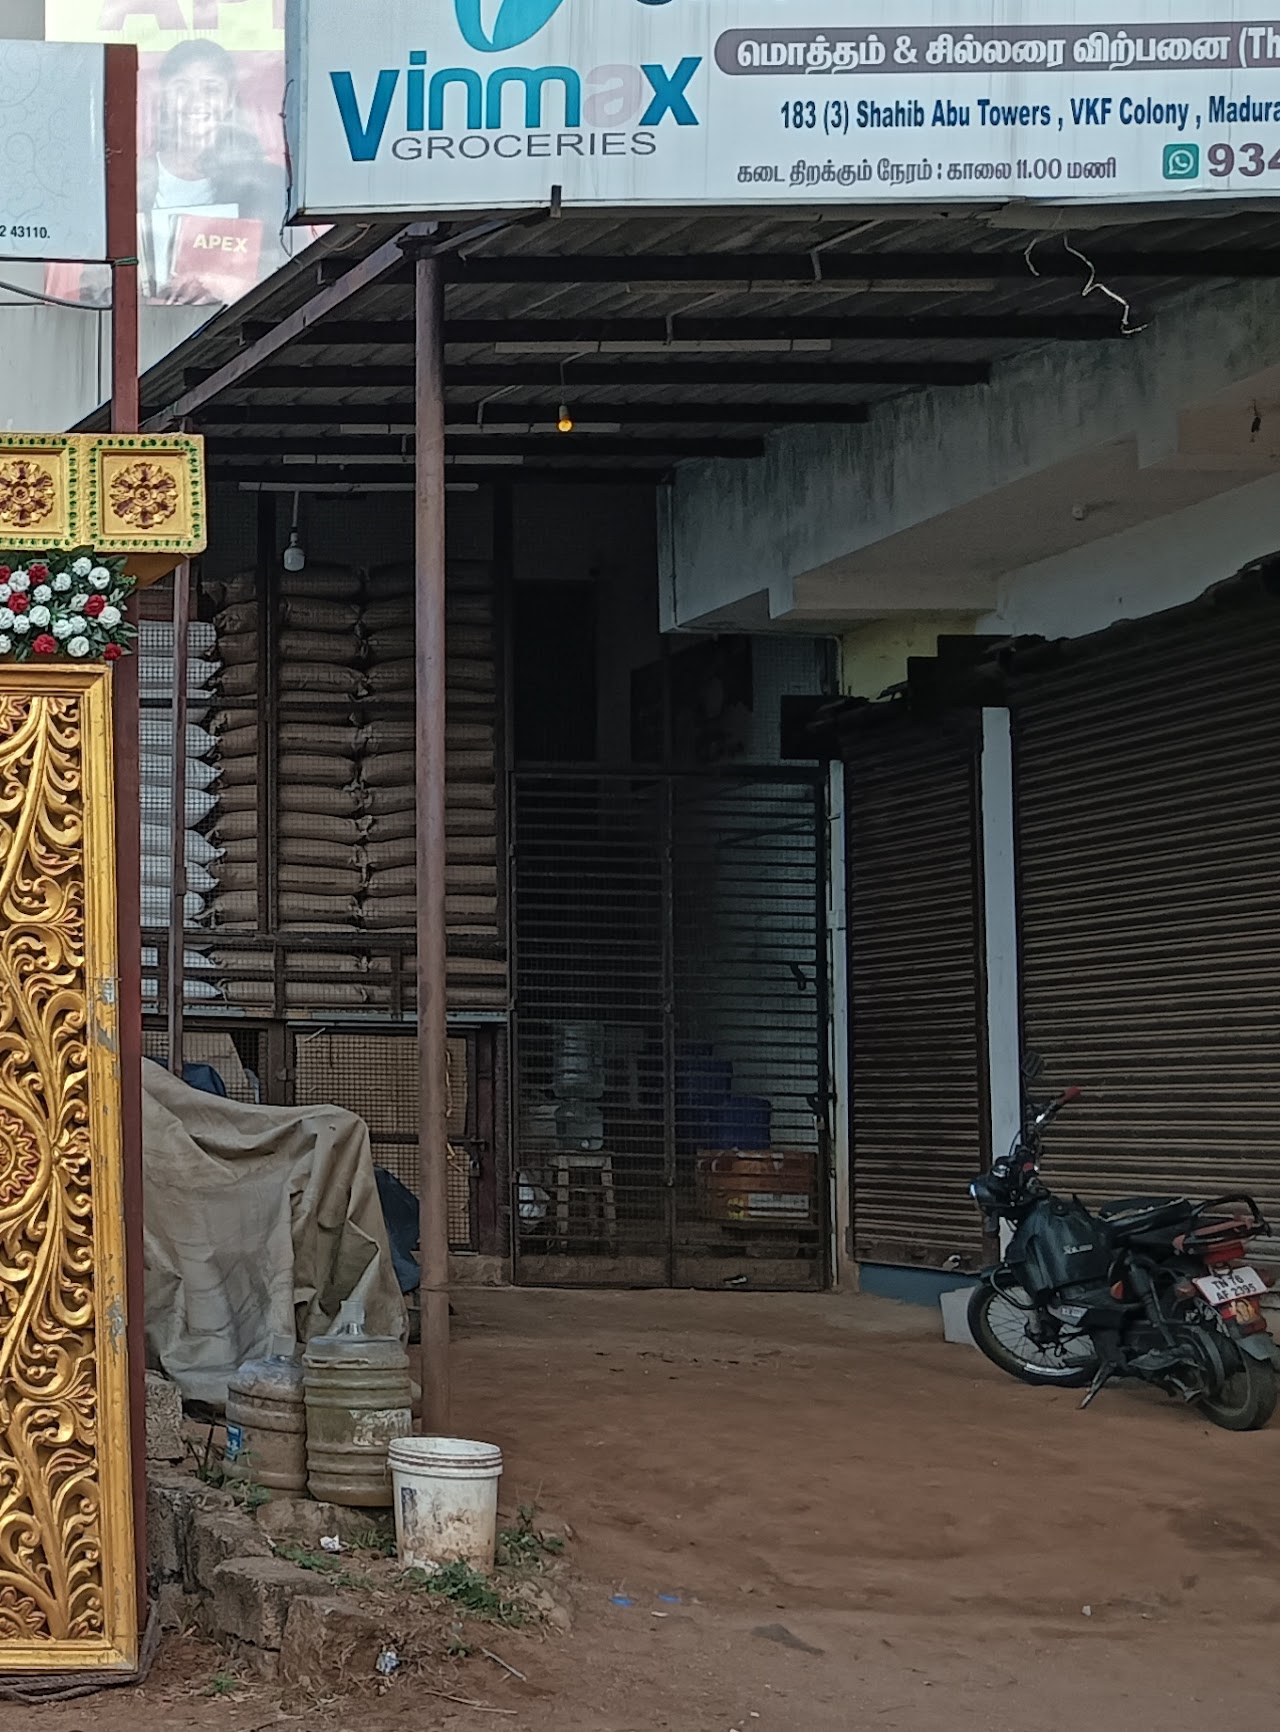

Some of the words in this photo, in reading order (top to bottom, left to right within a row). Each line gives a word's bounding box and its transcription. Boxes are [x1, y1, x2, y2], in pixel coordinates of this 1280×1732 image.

[737, 34, 886, 75] மொத்தம்
[893, 36, 918, 64] &
[925, 33, 1066, 68] சில்லரை
[1073, 30, 1231, 70] விற்பனை
[781, 101, 816, 129] 183
[823, 100, 849, 135] (3)
[856, 99, 925, 128] Shahib
[931, 99, 970, 127] Abu
[977, 98, 1051, 126] Towers
[1070, 97, 1113, 126] VKF
[1119, 96, 1189, 131] Colony
[391, 131, 657, 162] GROCERIES
[737, 165, 785, 183] கடை
[789, 159, 872, 188] திறக்கும்
[876, 158, 933, 186] நேரம்
[946, 161, 1012, 181] காலை
[1016, 157, 1062, 180] 11.00
[1066, 156, 1117, 179] மணி
[192, 233, 248, 253] APEX
